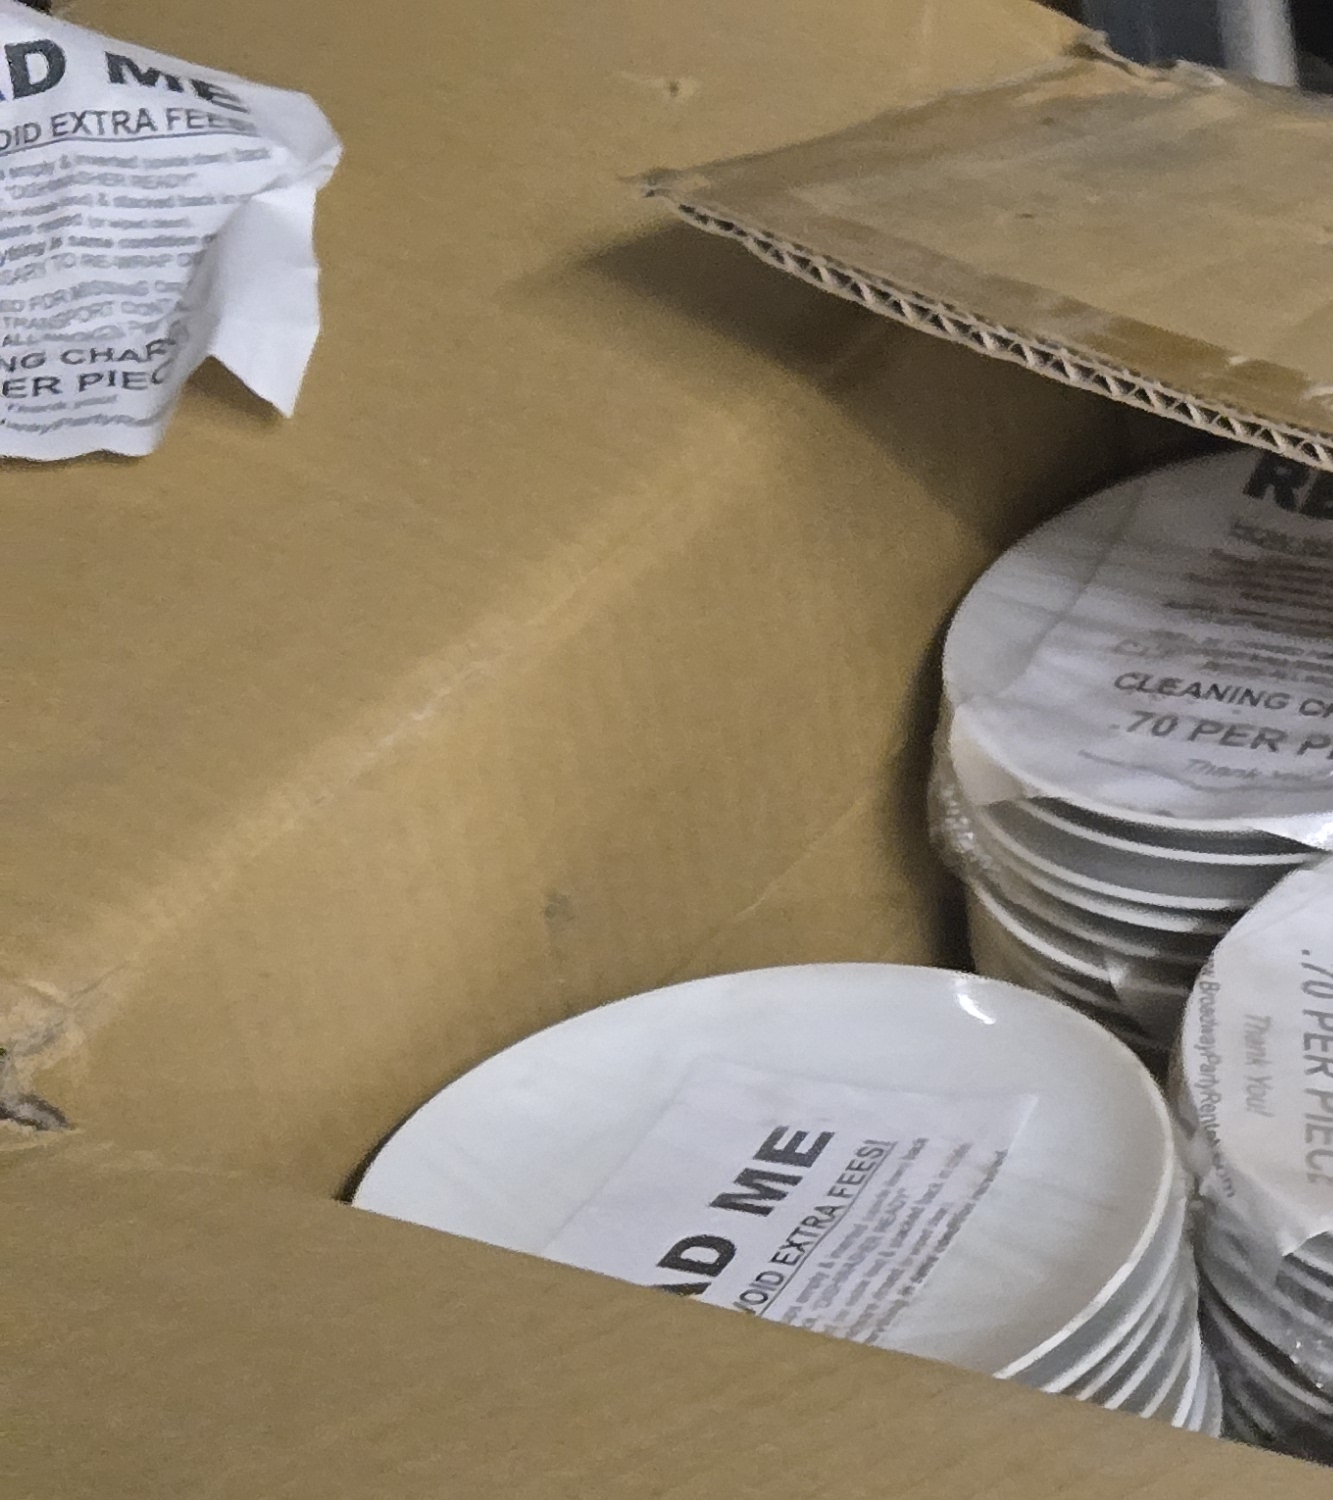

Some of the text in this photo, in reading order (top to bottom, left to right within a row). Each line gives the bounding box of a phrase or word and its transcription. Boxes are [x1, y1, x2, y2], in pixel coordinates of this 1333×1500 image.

[51, 107, 158, 137] EXTRA
[1, 376, 63, 399] ER
[78, 358, 176, 393] PIEC
[1114, 672, 1291, 711] CLEANING
[1187, 717, 1289, 752] PER
[1245, 1013, 1273, 1064] Thank
[708, 1125, 836, 1218] ME
[769, 1203, 845, 1267] EXTRA
[826, 1139, 894, 1200] FEES!
